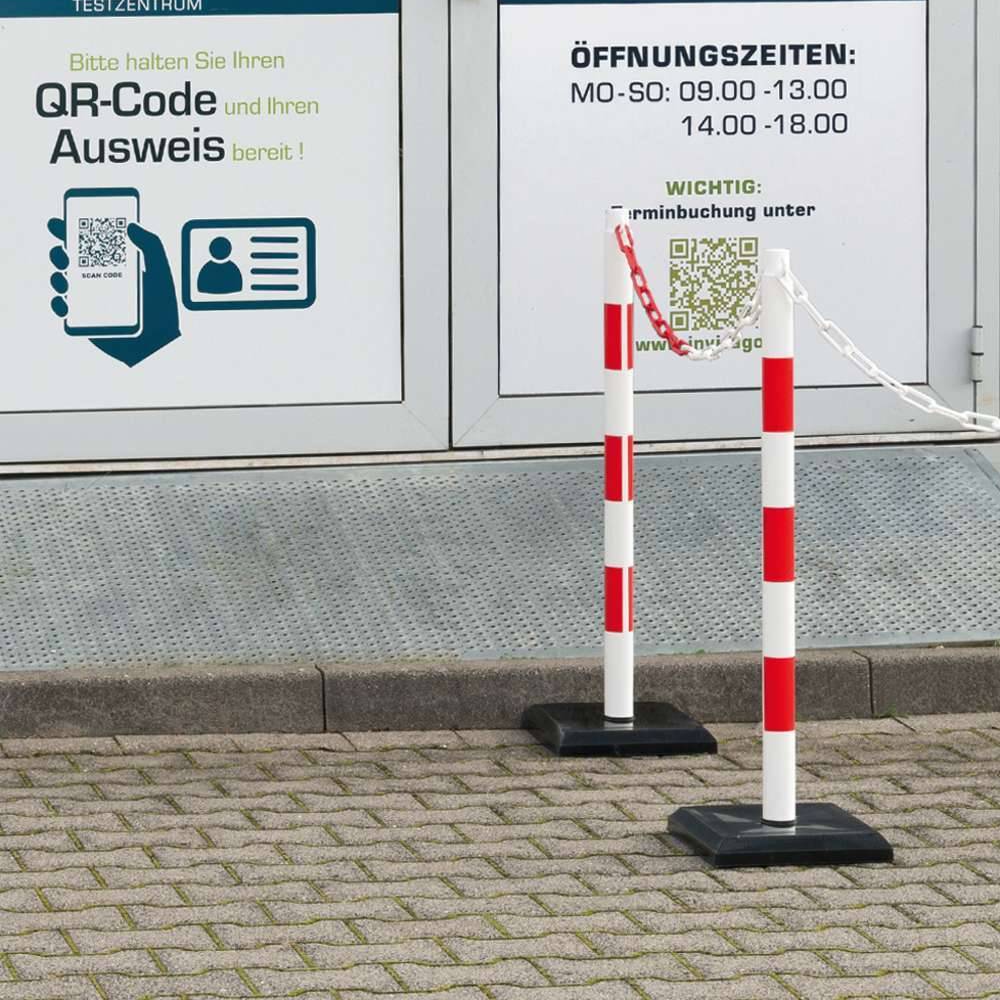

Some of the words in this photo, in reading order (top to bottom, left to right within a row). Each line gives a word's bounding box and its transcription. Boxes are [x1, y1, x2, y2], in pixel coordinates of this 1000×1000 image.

[70, 53, 119, 71] Bitte
[126, 52, 189, 71] halten
[195, 51, 226, 69] Sie
[233, 51, 285, 69] Ihren
[570, 40, 856, 68] ÖFFNUNGSZEITEN:
[35, 81, 217, 118] QR-Code
[224, 98, 261, 116] und
[268, 96, 320, 115] Ihren
[679, 80, 756, 102] 09.00
[681, 114, 757, 136] 14.00
[49, 126, 226, 165] Ausweis
[232, 143, 292, 161] bereit
[666, 180, 763, 196] WICHTIG:
[611, 205, 757, 221] rminbuchung
[763, 204, 816, 217] unter
